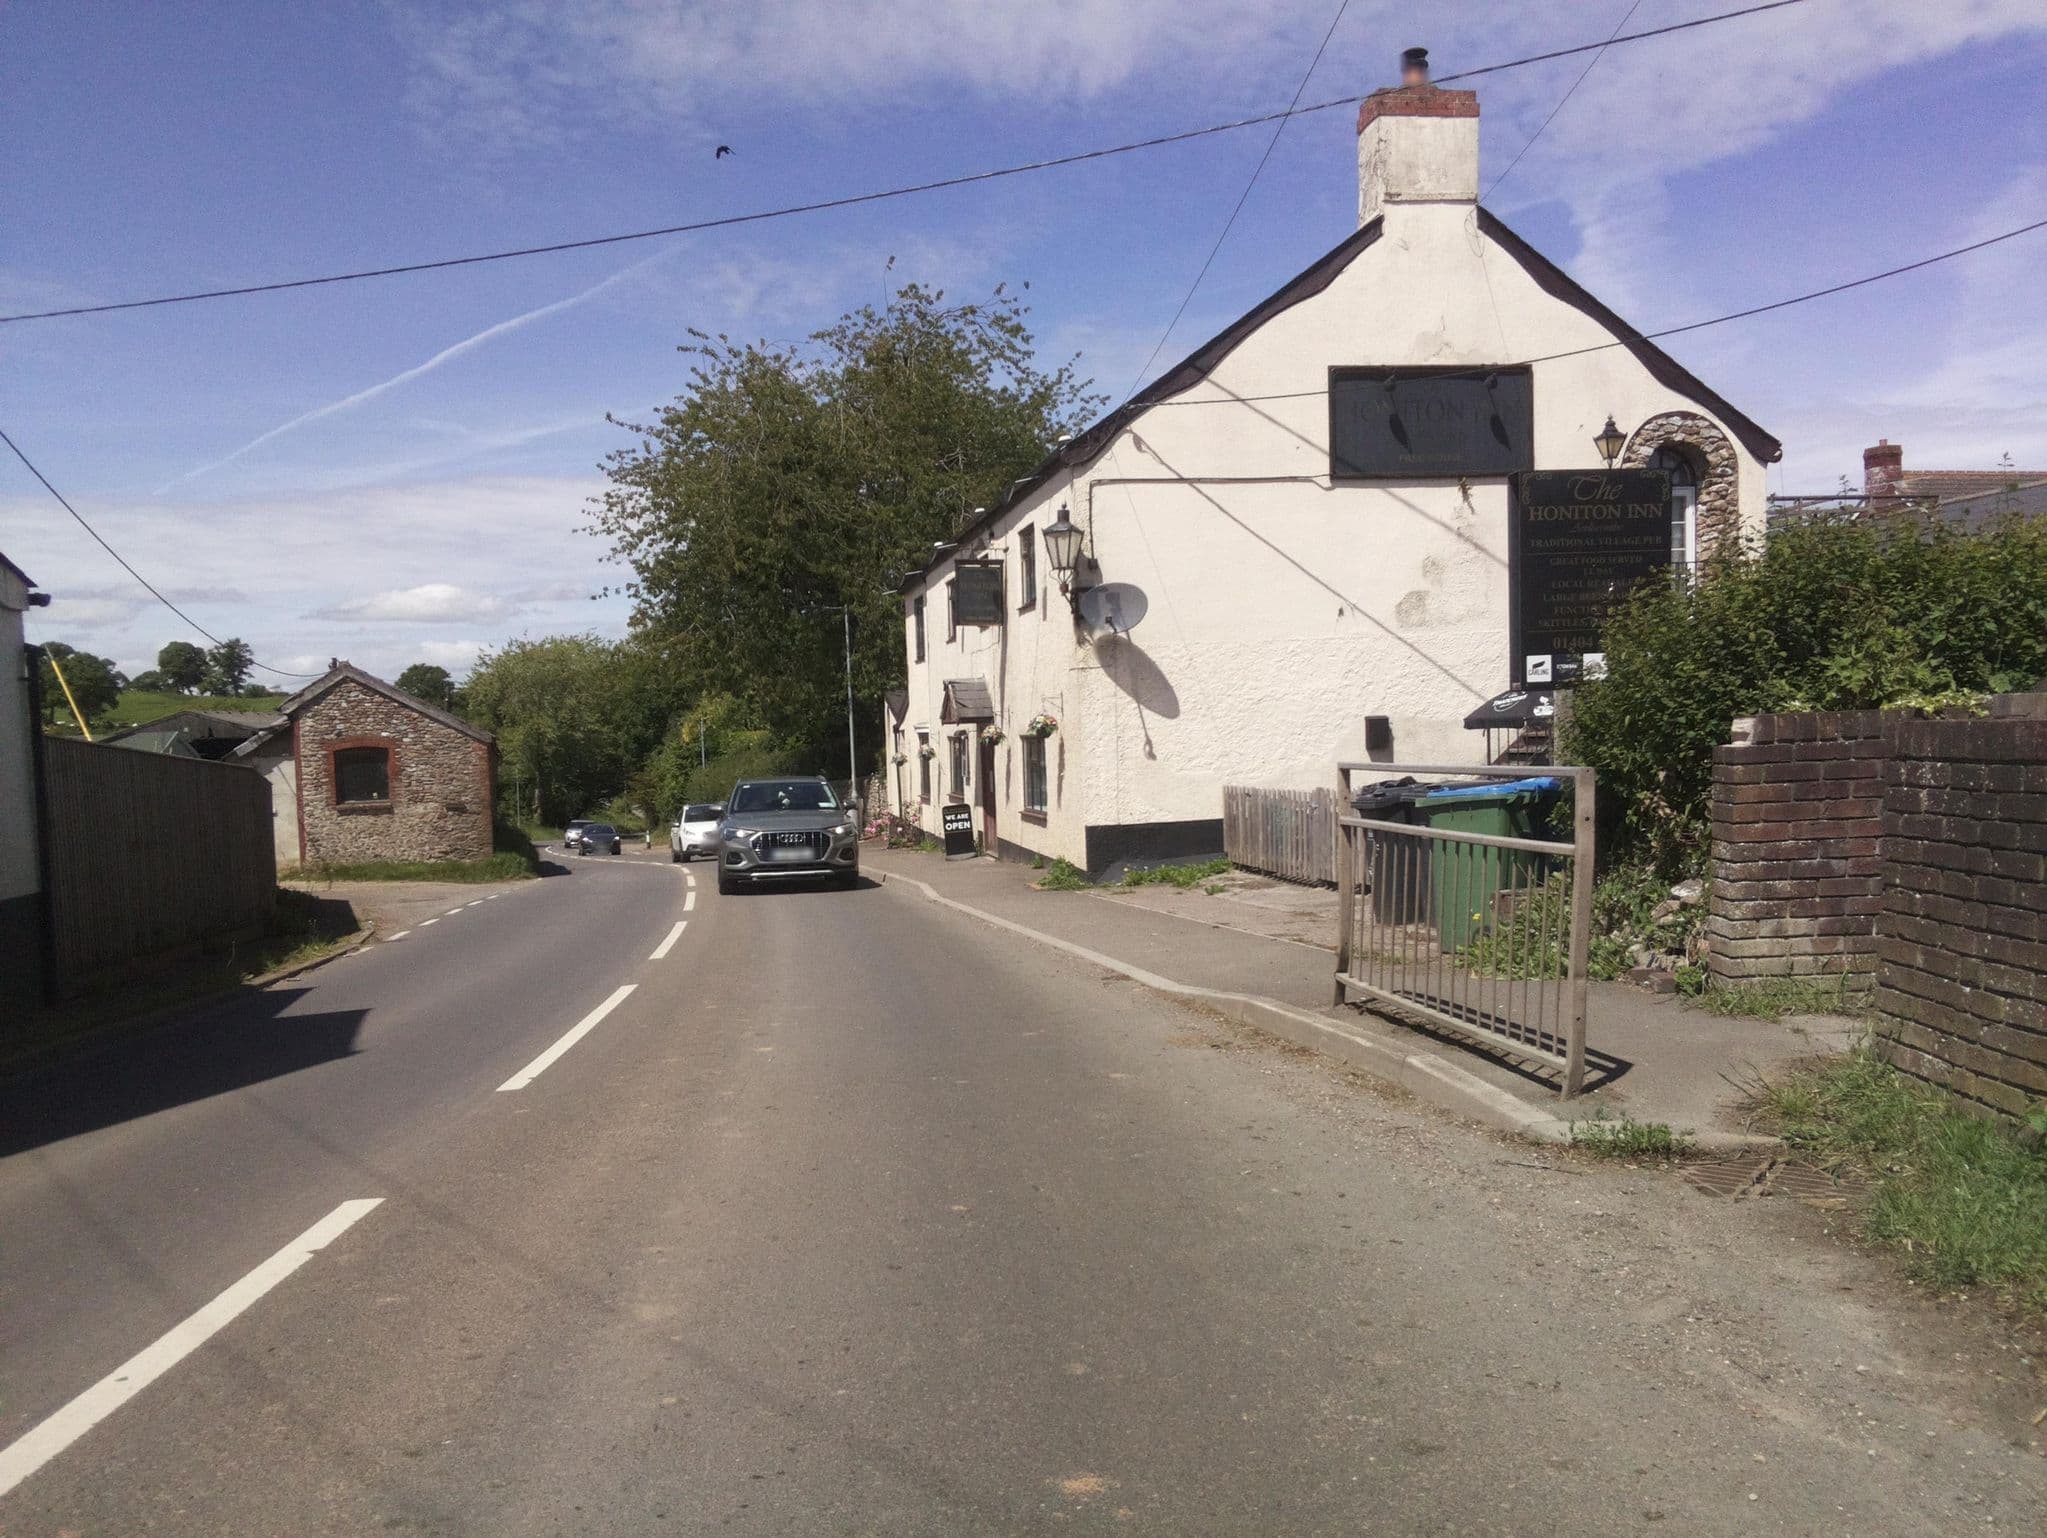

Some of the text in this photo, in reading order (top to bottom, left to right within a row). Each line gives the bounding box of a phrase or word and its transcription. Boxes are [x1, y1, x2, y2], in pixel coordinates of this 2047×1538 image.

[1567, 474, 1624, 502] The
[1528, 503, 1664, 521] HONITON INN
[1530, 537, 1596, 548] TRADITIONAL
[945, 821, 971, 831] OPEN
